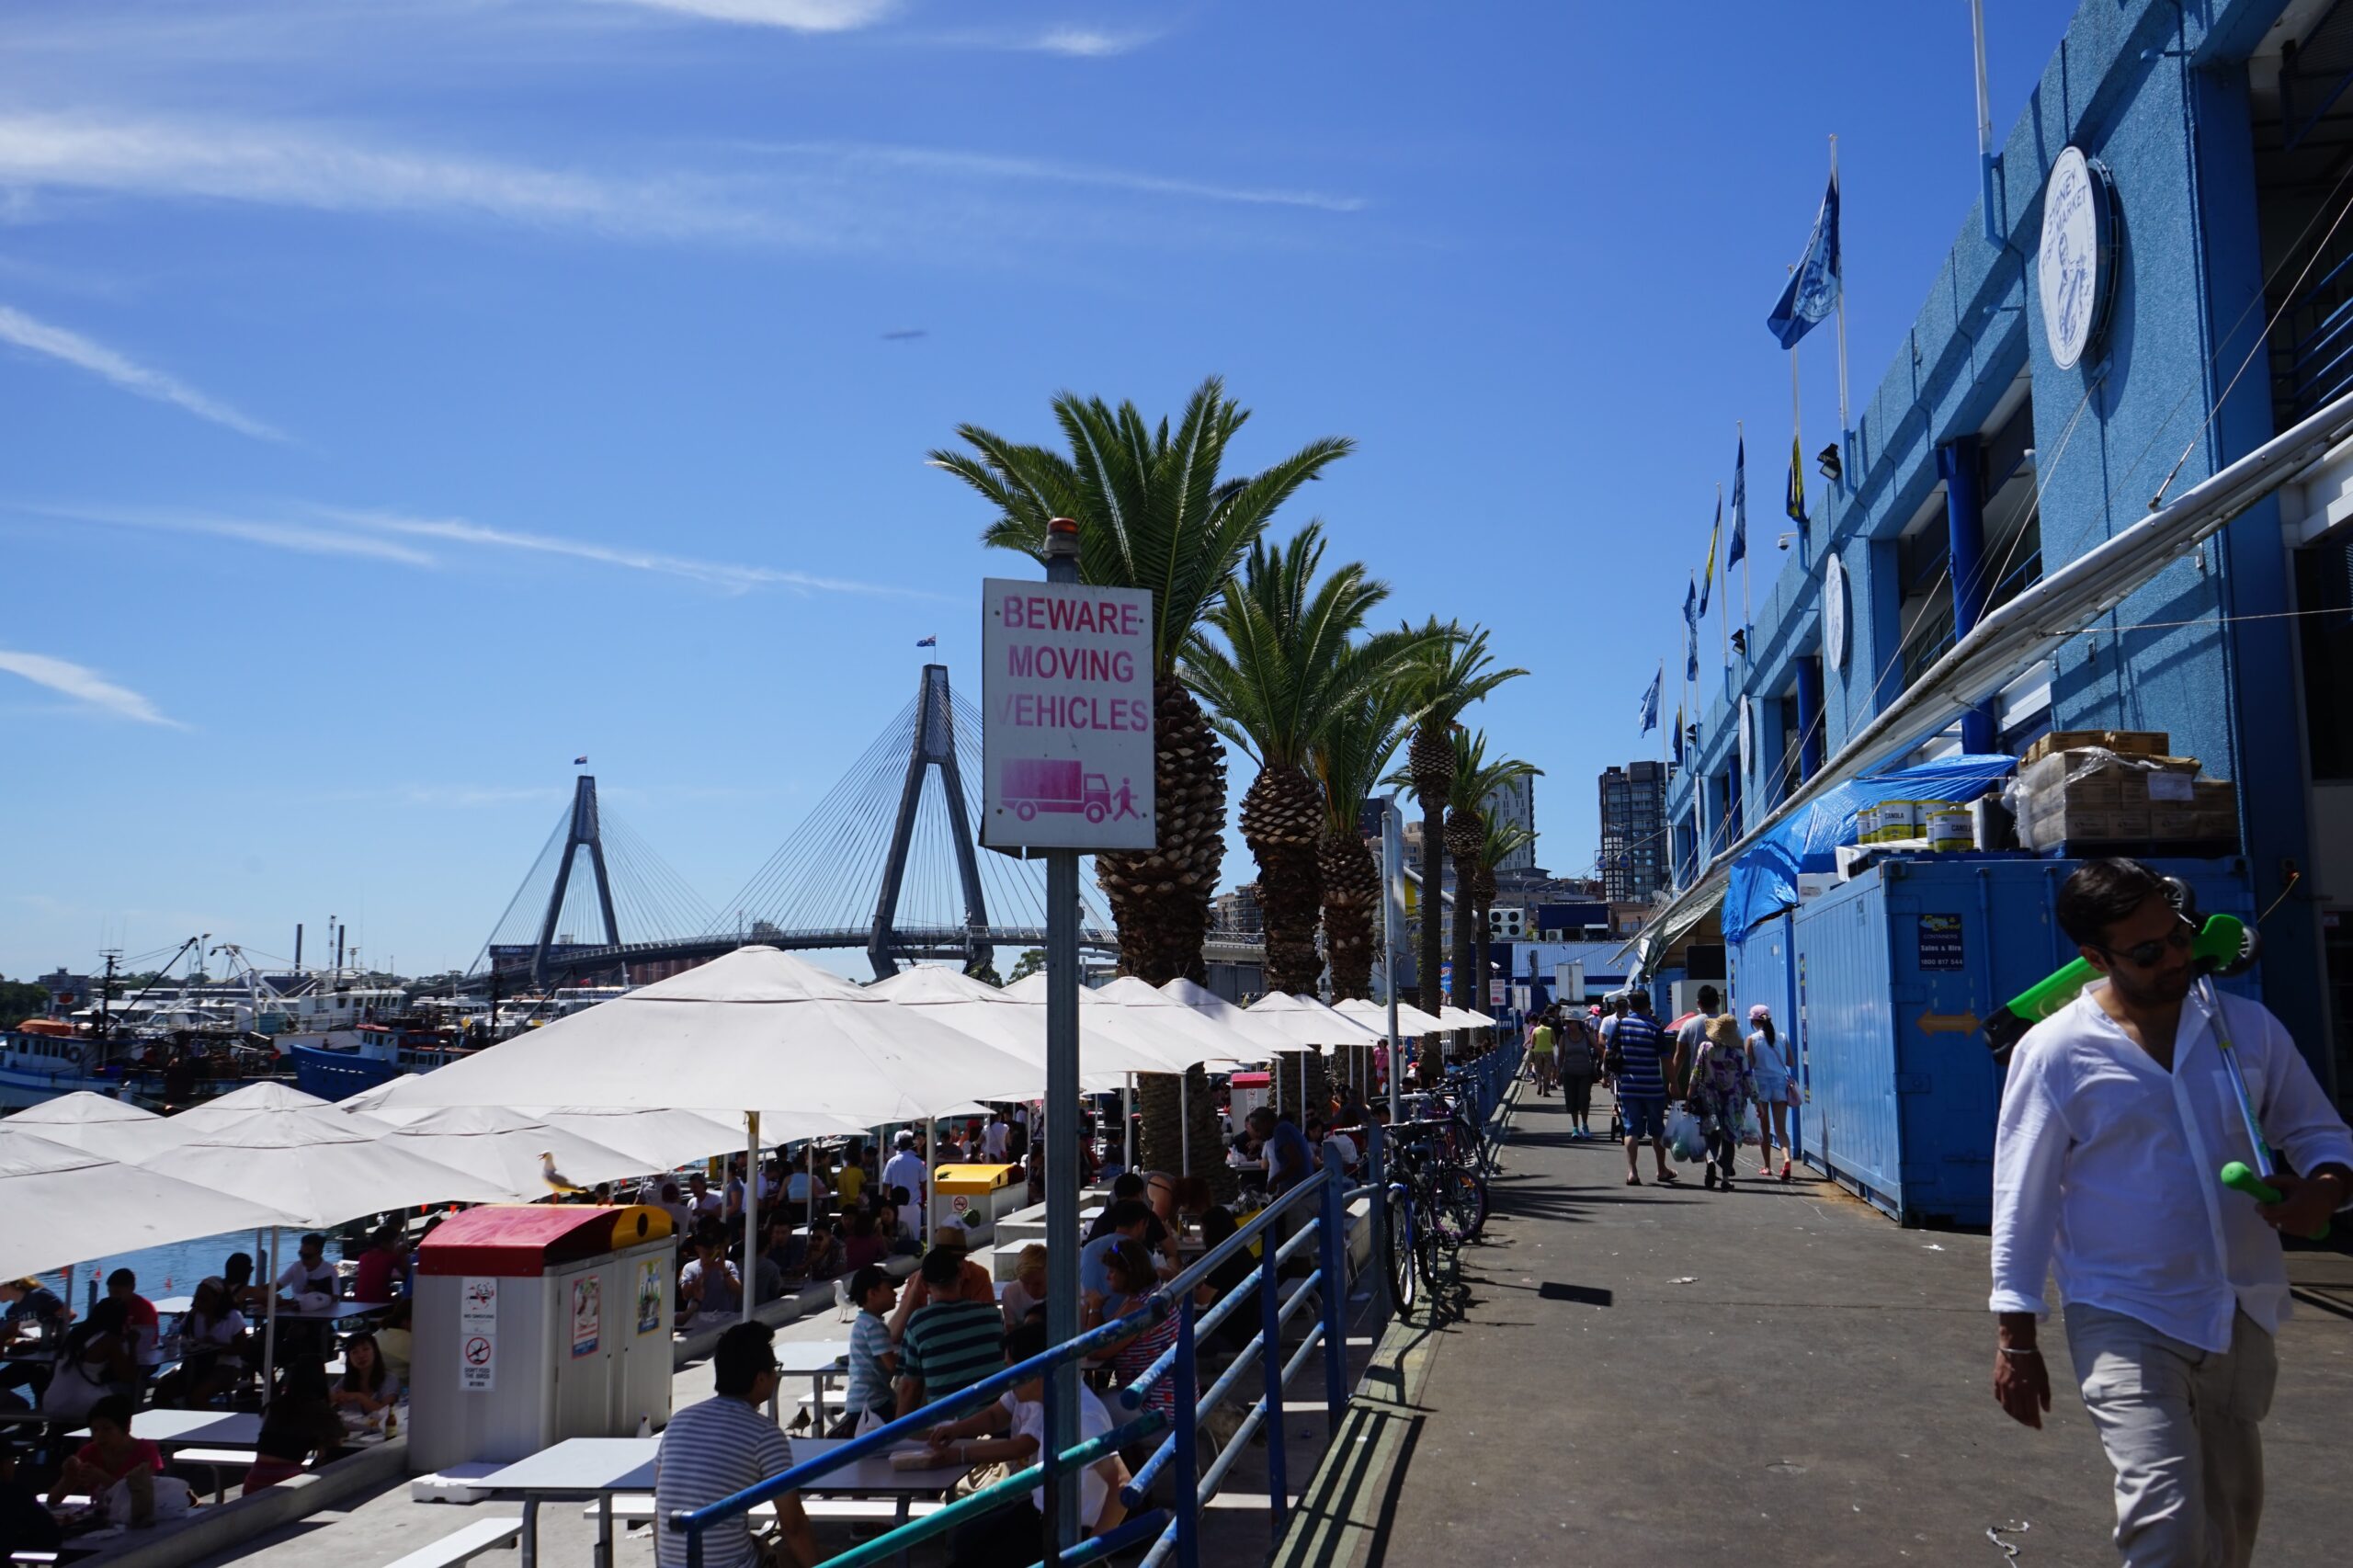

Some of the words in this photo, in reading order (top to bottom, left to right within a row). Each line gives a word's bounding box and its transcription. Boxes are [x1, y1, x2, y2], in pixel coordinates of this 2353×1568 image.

[2048, 167, 2079, 233] SYDNEY
[2040, 234, 2056, 273] FISH
[2055, 184, 2086, 235] MARKET
[1004, 595, 1139, 635] BEWARE
[1008, 645, 1134, 683] MOVING
[995, 692, 1149, 732] VEHICLES
[1885, 812, 1904, 820] CANOLA
